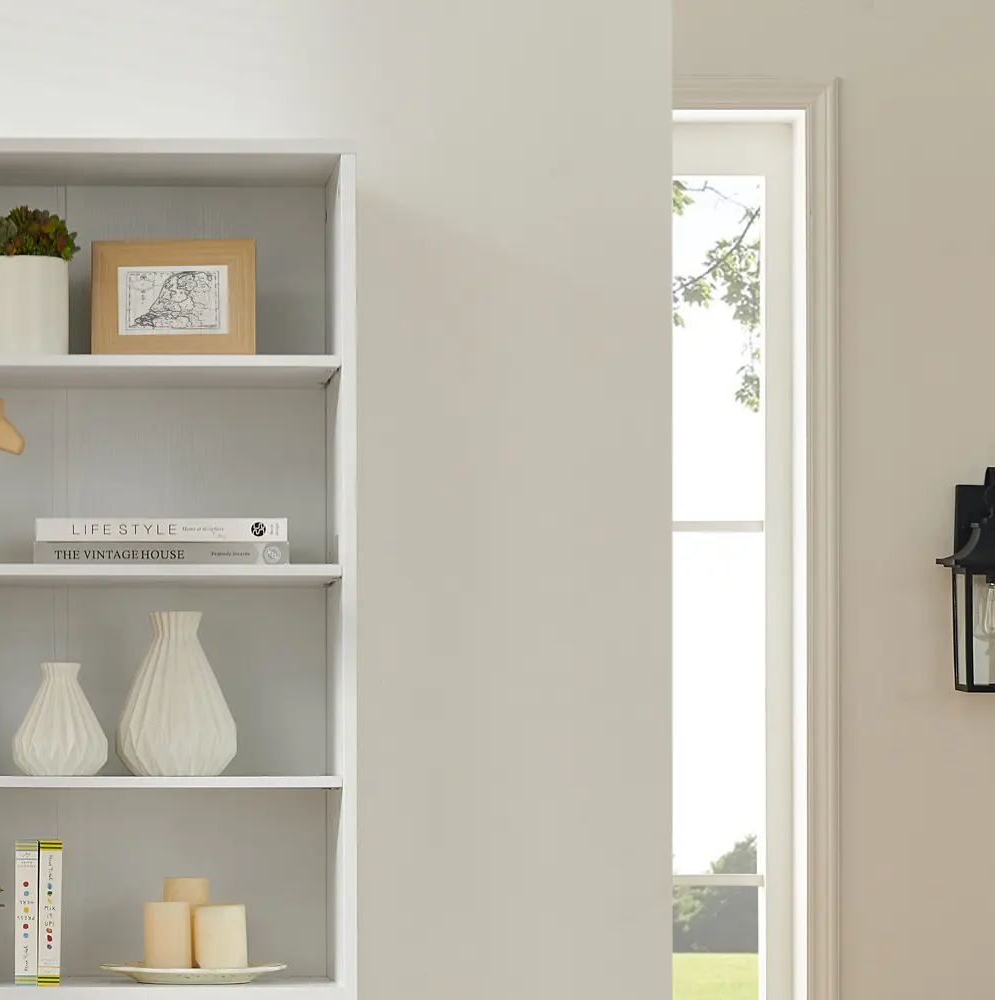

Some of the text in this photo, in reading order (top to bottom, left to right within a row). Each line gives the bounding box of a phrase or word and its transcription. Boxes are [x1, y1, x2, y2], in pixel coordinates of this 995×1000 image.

[119, 524, 177, 535] STYLE
[54, 550, 185, 560] THE VINTAGE HOUSE
